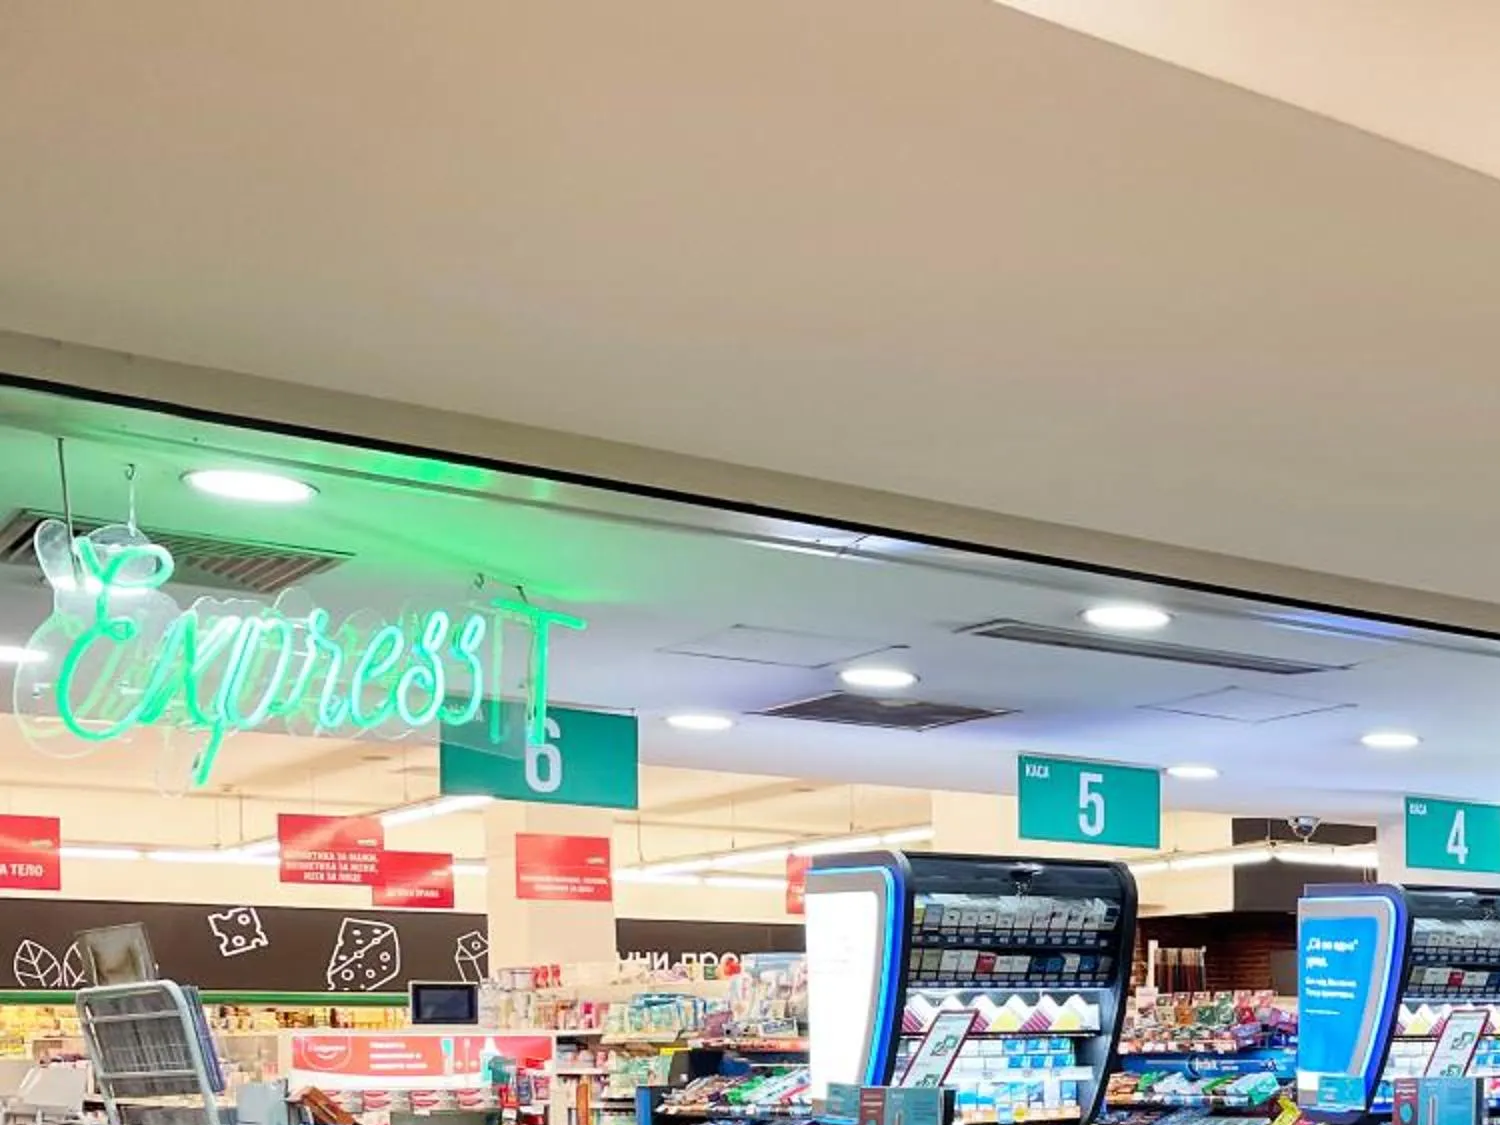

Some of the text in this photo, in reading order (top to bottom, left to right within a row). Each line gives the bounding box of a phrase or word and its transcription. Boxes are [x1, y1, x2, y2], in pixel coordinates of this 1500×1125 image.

[526, 717, 562, 793] 6
[1078, 772, 1105, 837] 5
[1446, 809, 1469, 865] 4
